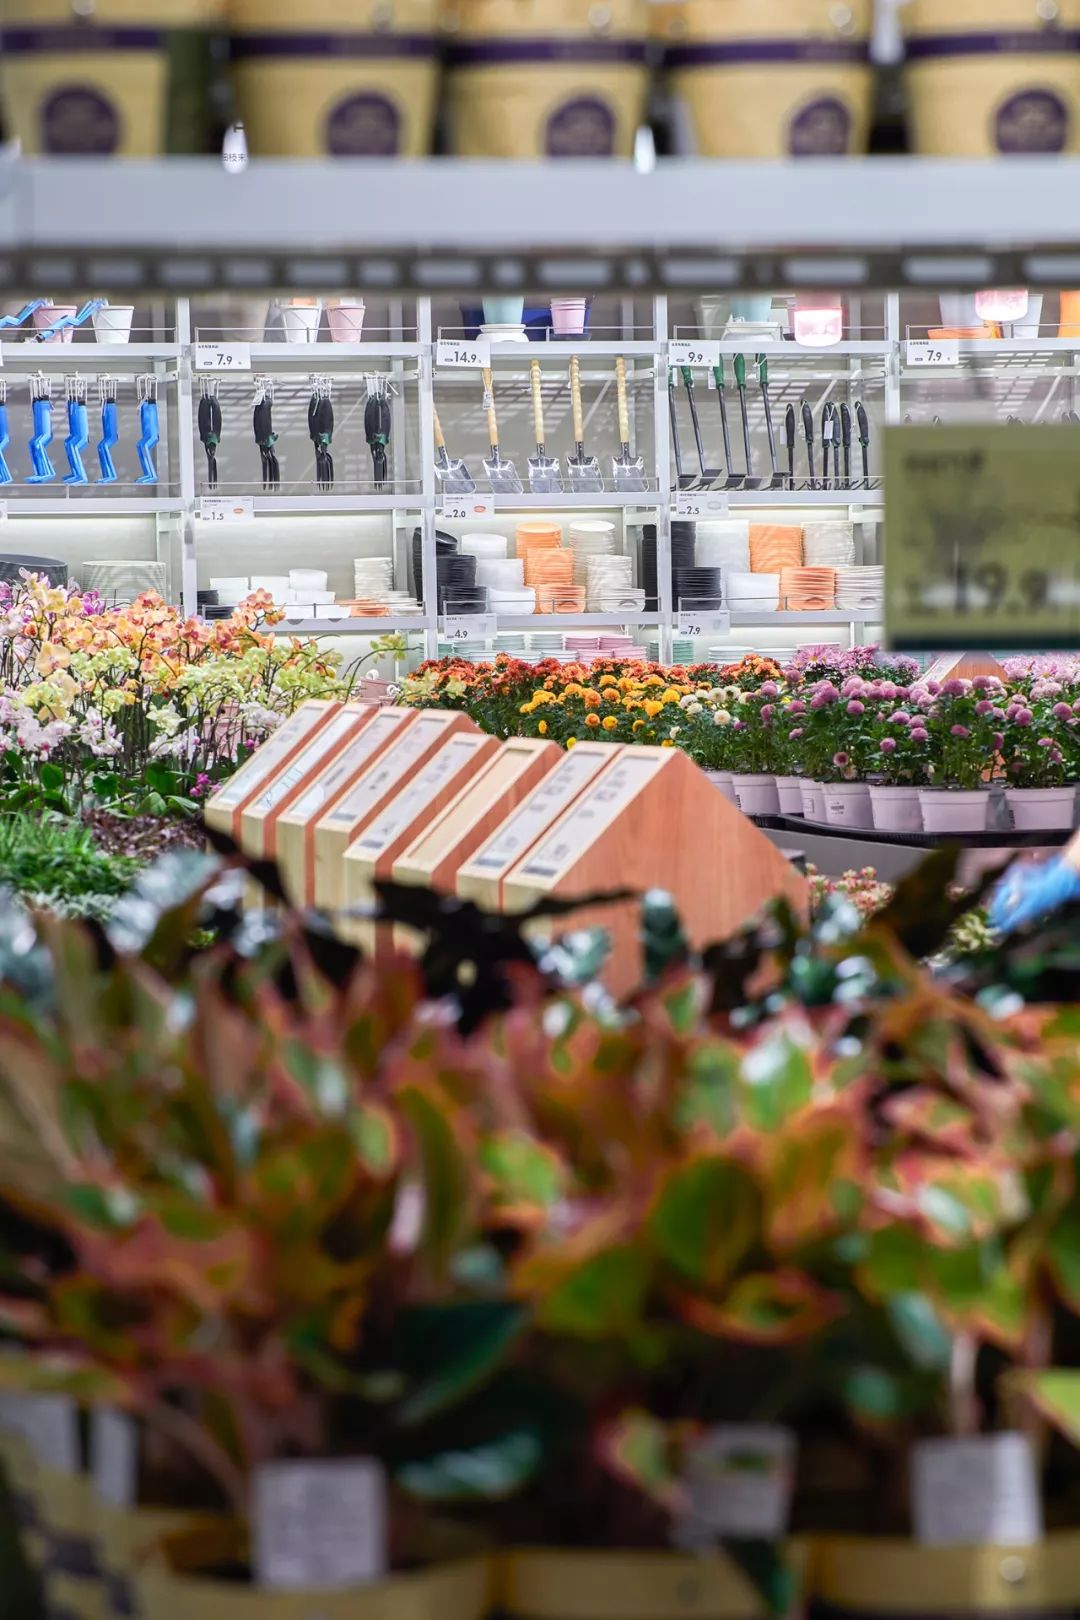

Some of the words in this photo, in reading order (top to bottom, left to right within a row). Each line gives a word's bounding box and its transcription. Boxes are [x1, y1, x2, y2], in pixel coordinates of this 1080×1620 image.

[217, 354, 232, 365] 7.9
[454, 351, 476, 363] 14.9
[688, 352, 703, 362] 9.9
[927, 350, 942, 361] 7.9
[453, 509, 466, 518] 2.0
[686, 506, 699, 514] 2.5
[212, 512, 224, 521] 1.5
[455, 629, 468, 639] 4.9
[688, 626, 700, 635] 7.9
